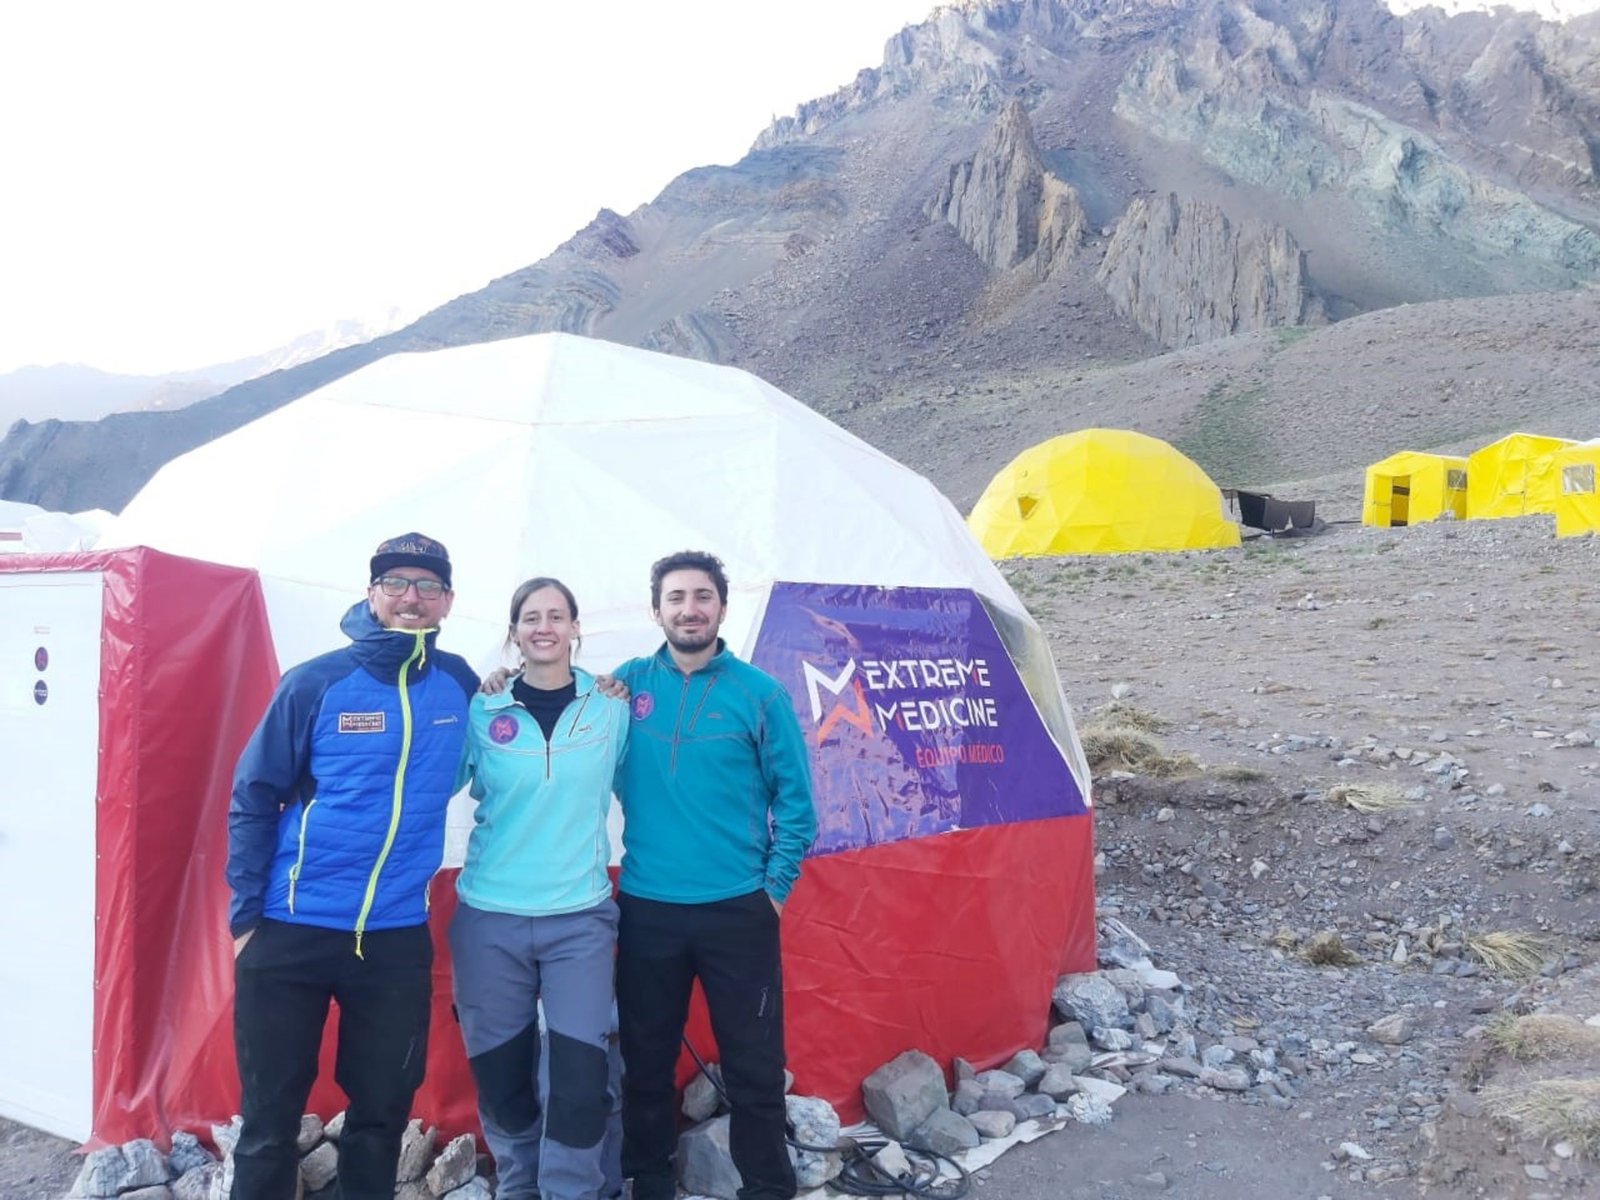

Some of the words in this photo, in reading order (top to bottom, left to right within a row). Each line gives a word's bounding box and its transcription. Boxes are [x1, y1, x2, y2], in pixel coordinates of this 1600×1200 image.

[862, 658, 991, 690] EXTREME
[875, 698, 998, 732] MEDICINE
[916, 746, 967, 768] EQUIPO
